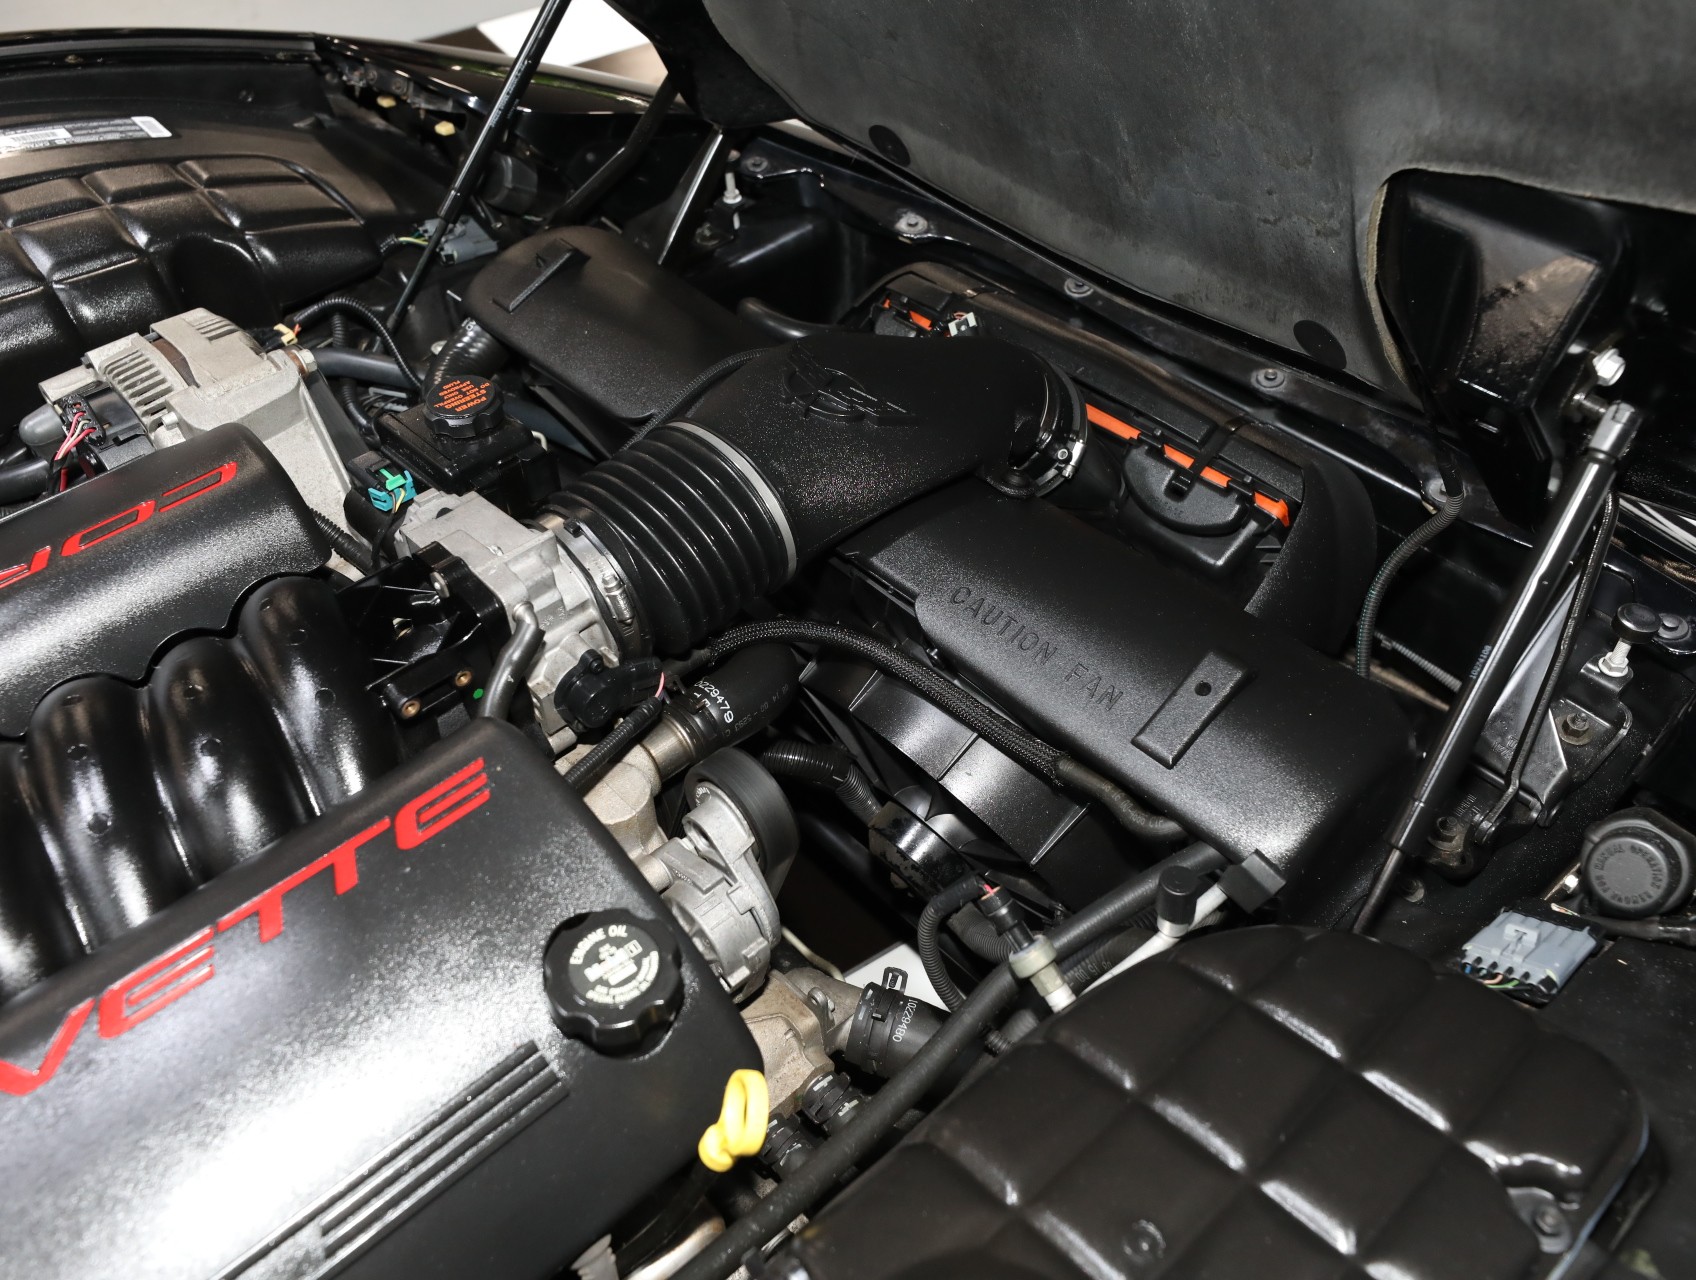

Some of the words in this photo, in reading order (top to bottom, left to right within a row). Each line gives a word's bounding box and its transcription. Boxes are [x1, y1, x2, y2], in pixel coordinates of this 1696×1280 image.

[438, 380, 471, 396] APPROVED
[461, 384, 475, 392] USE
[466, 387, 479, 396] NOT
[433, 394, 464, 408] OVERFILL
[444, 389, 487, 409] STEERING
[455, 396, 487, 412] POWER
[951, 586, 1058, 666] CAUTION
[1063, 662, 1124, 712] FAN
[0, 756, 491, 1096] VETTE
[569, 927, 607, 965] ENGINE
[608, 924, 628, 937] OIL
[892, 999, 918, 1043] 10229480
